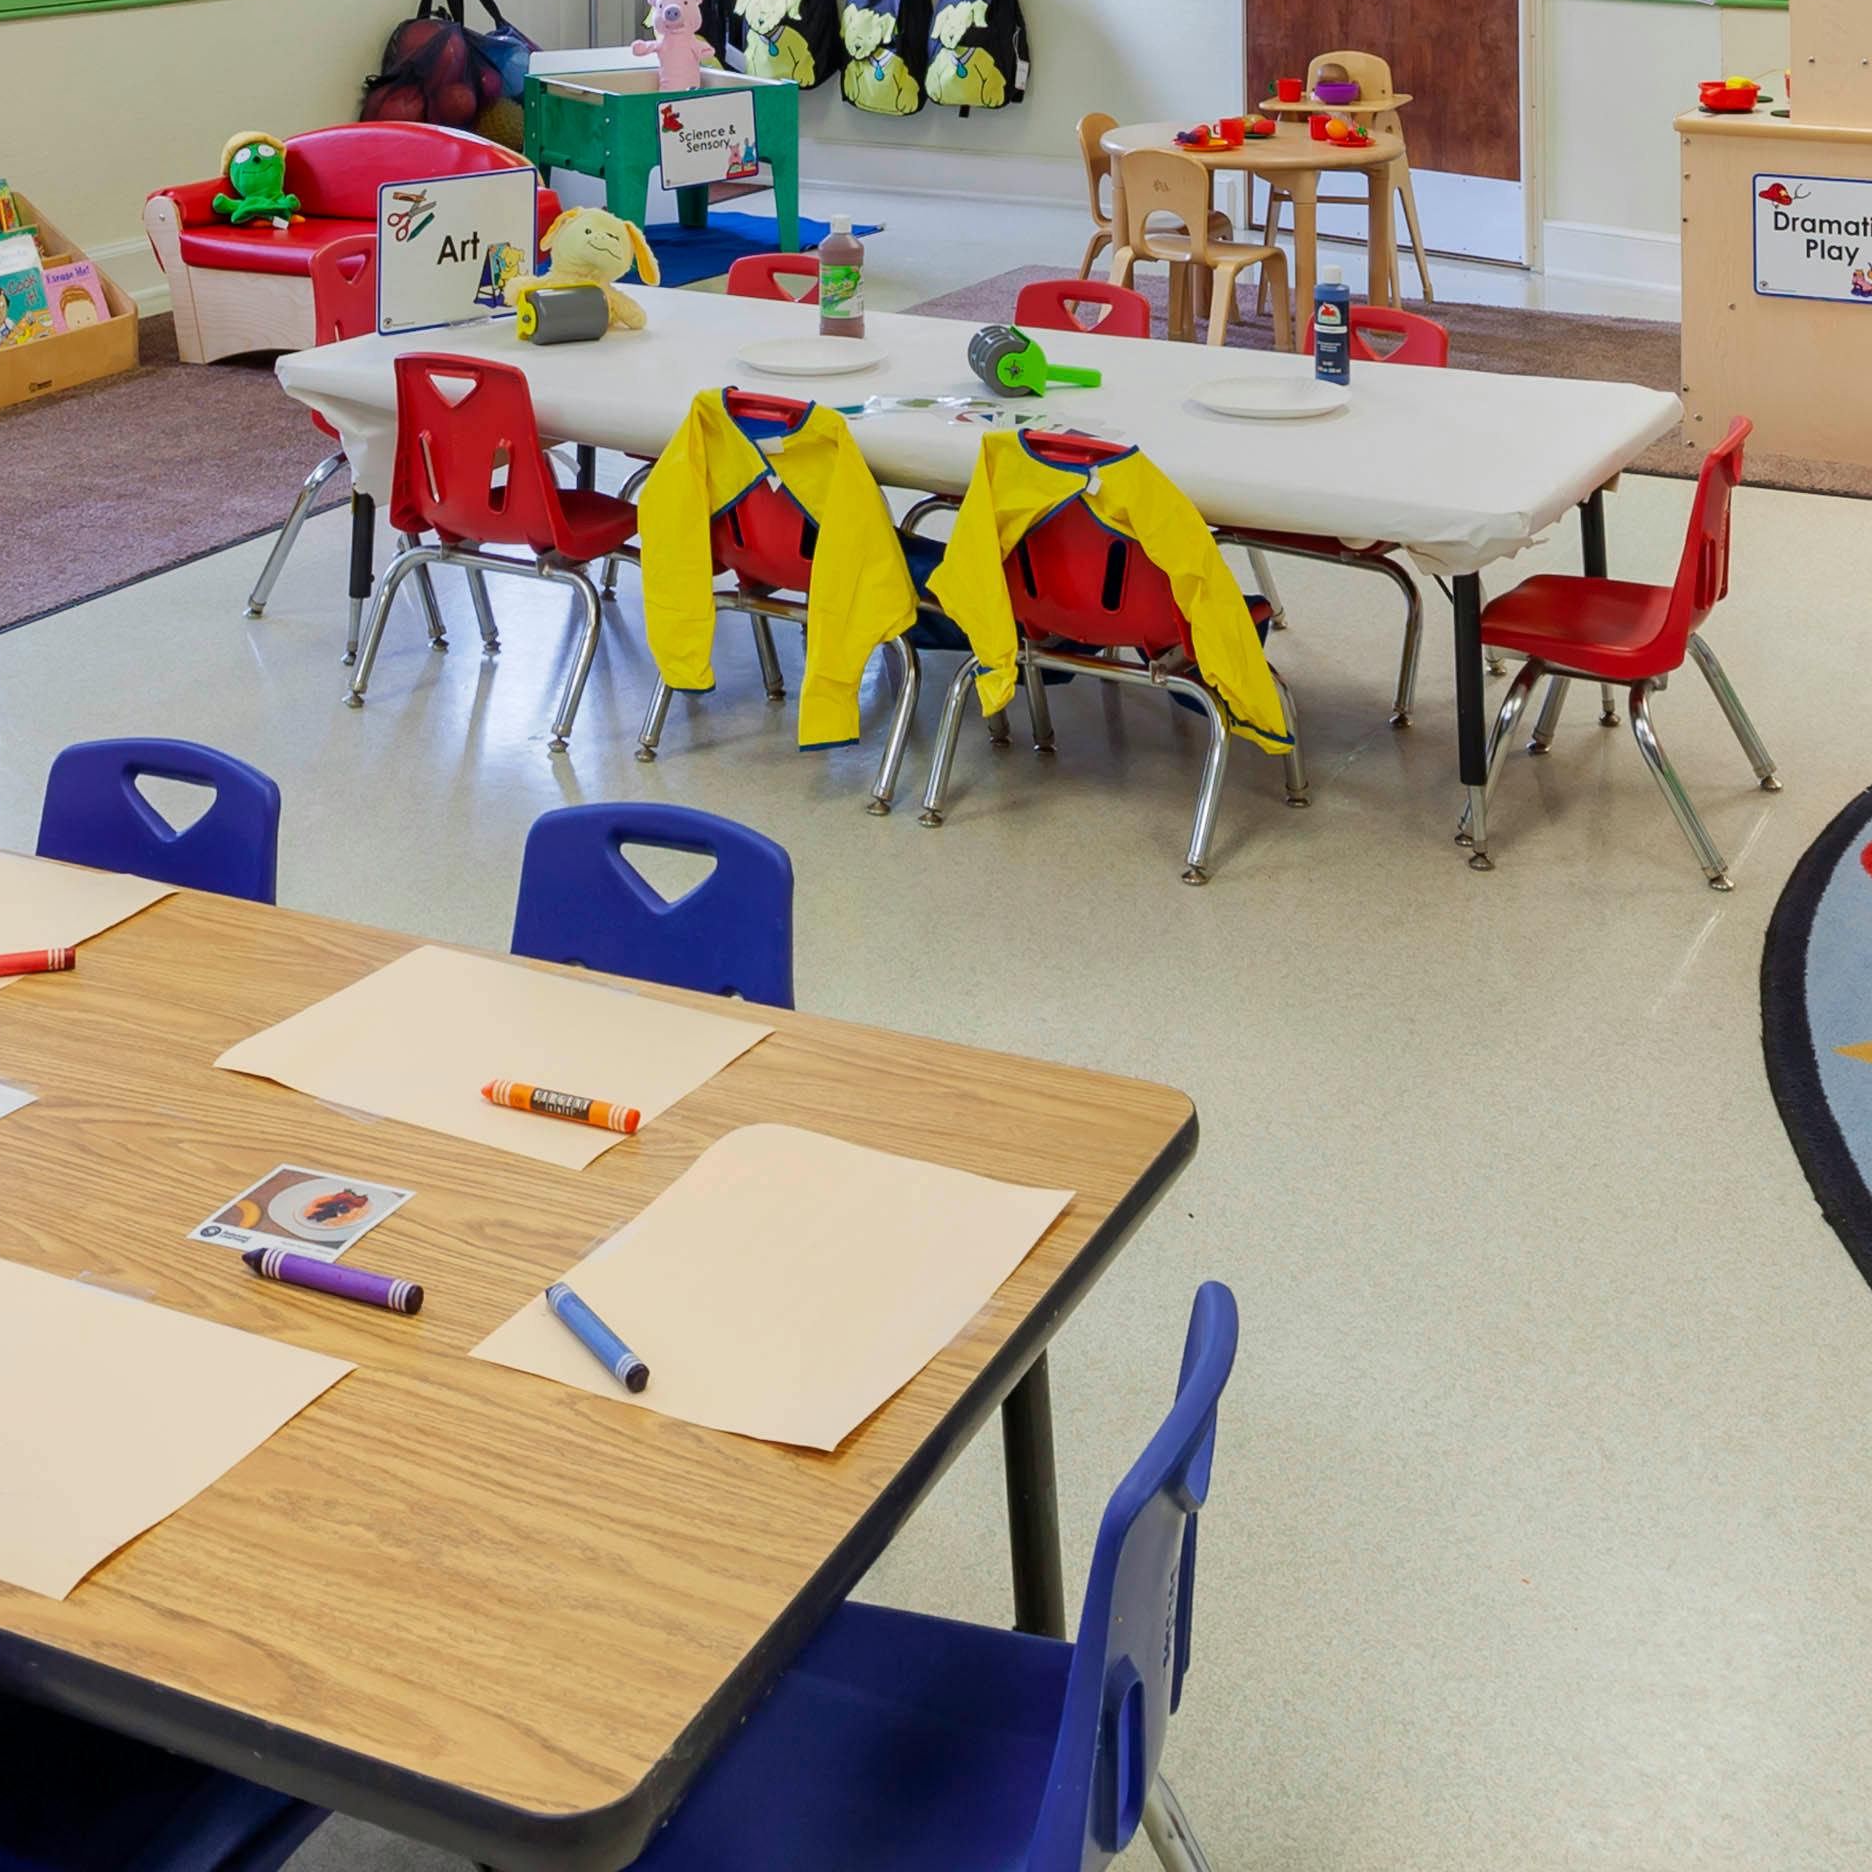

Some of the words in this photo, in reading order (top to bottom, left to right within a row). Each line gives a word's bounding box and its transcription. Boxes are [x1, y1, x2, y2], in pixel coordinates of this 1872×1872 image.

[679, 127, 726, 144] Science
[728, 124, 736, 136] &
[686, 138, 730, 154] Sensory
[436, 231, 481, 266] Art
[1805, 238, 1860, 267] Play
